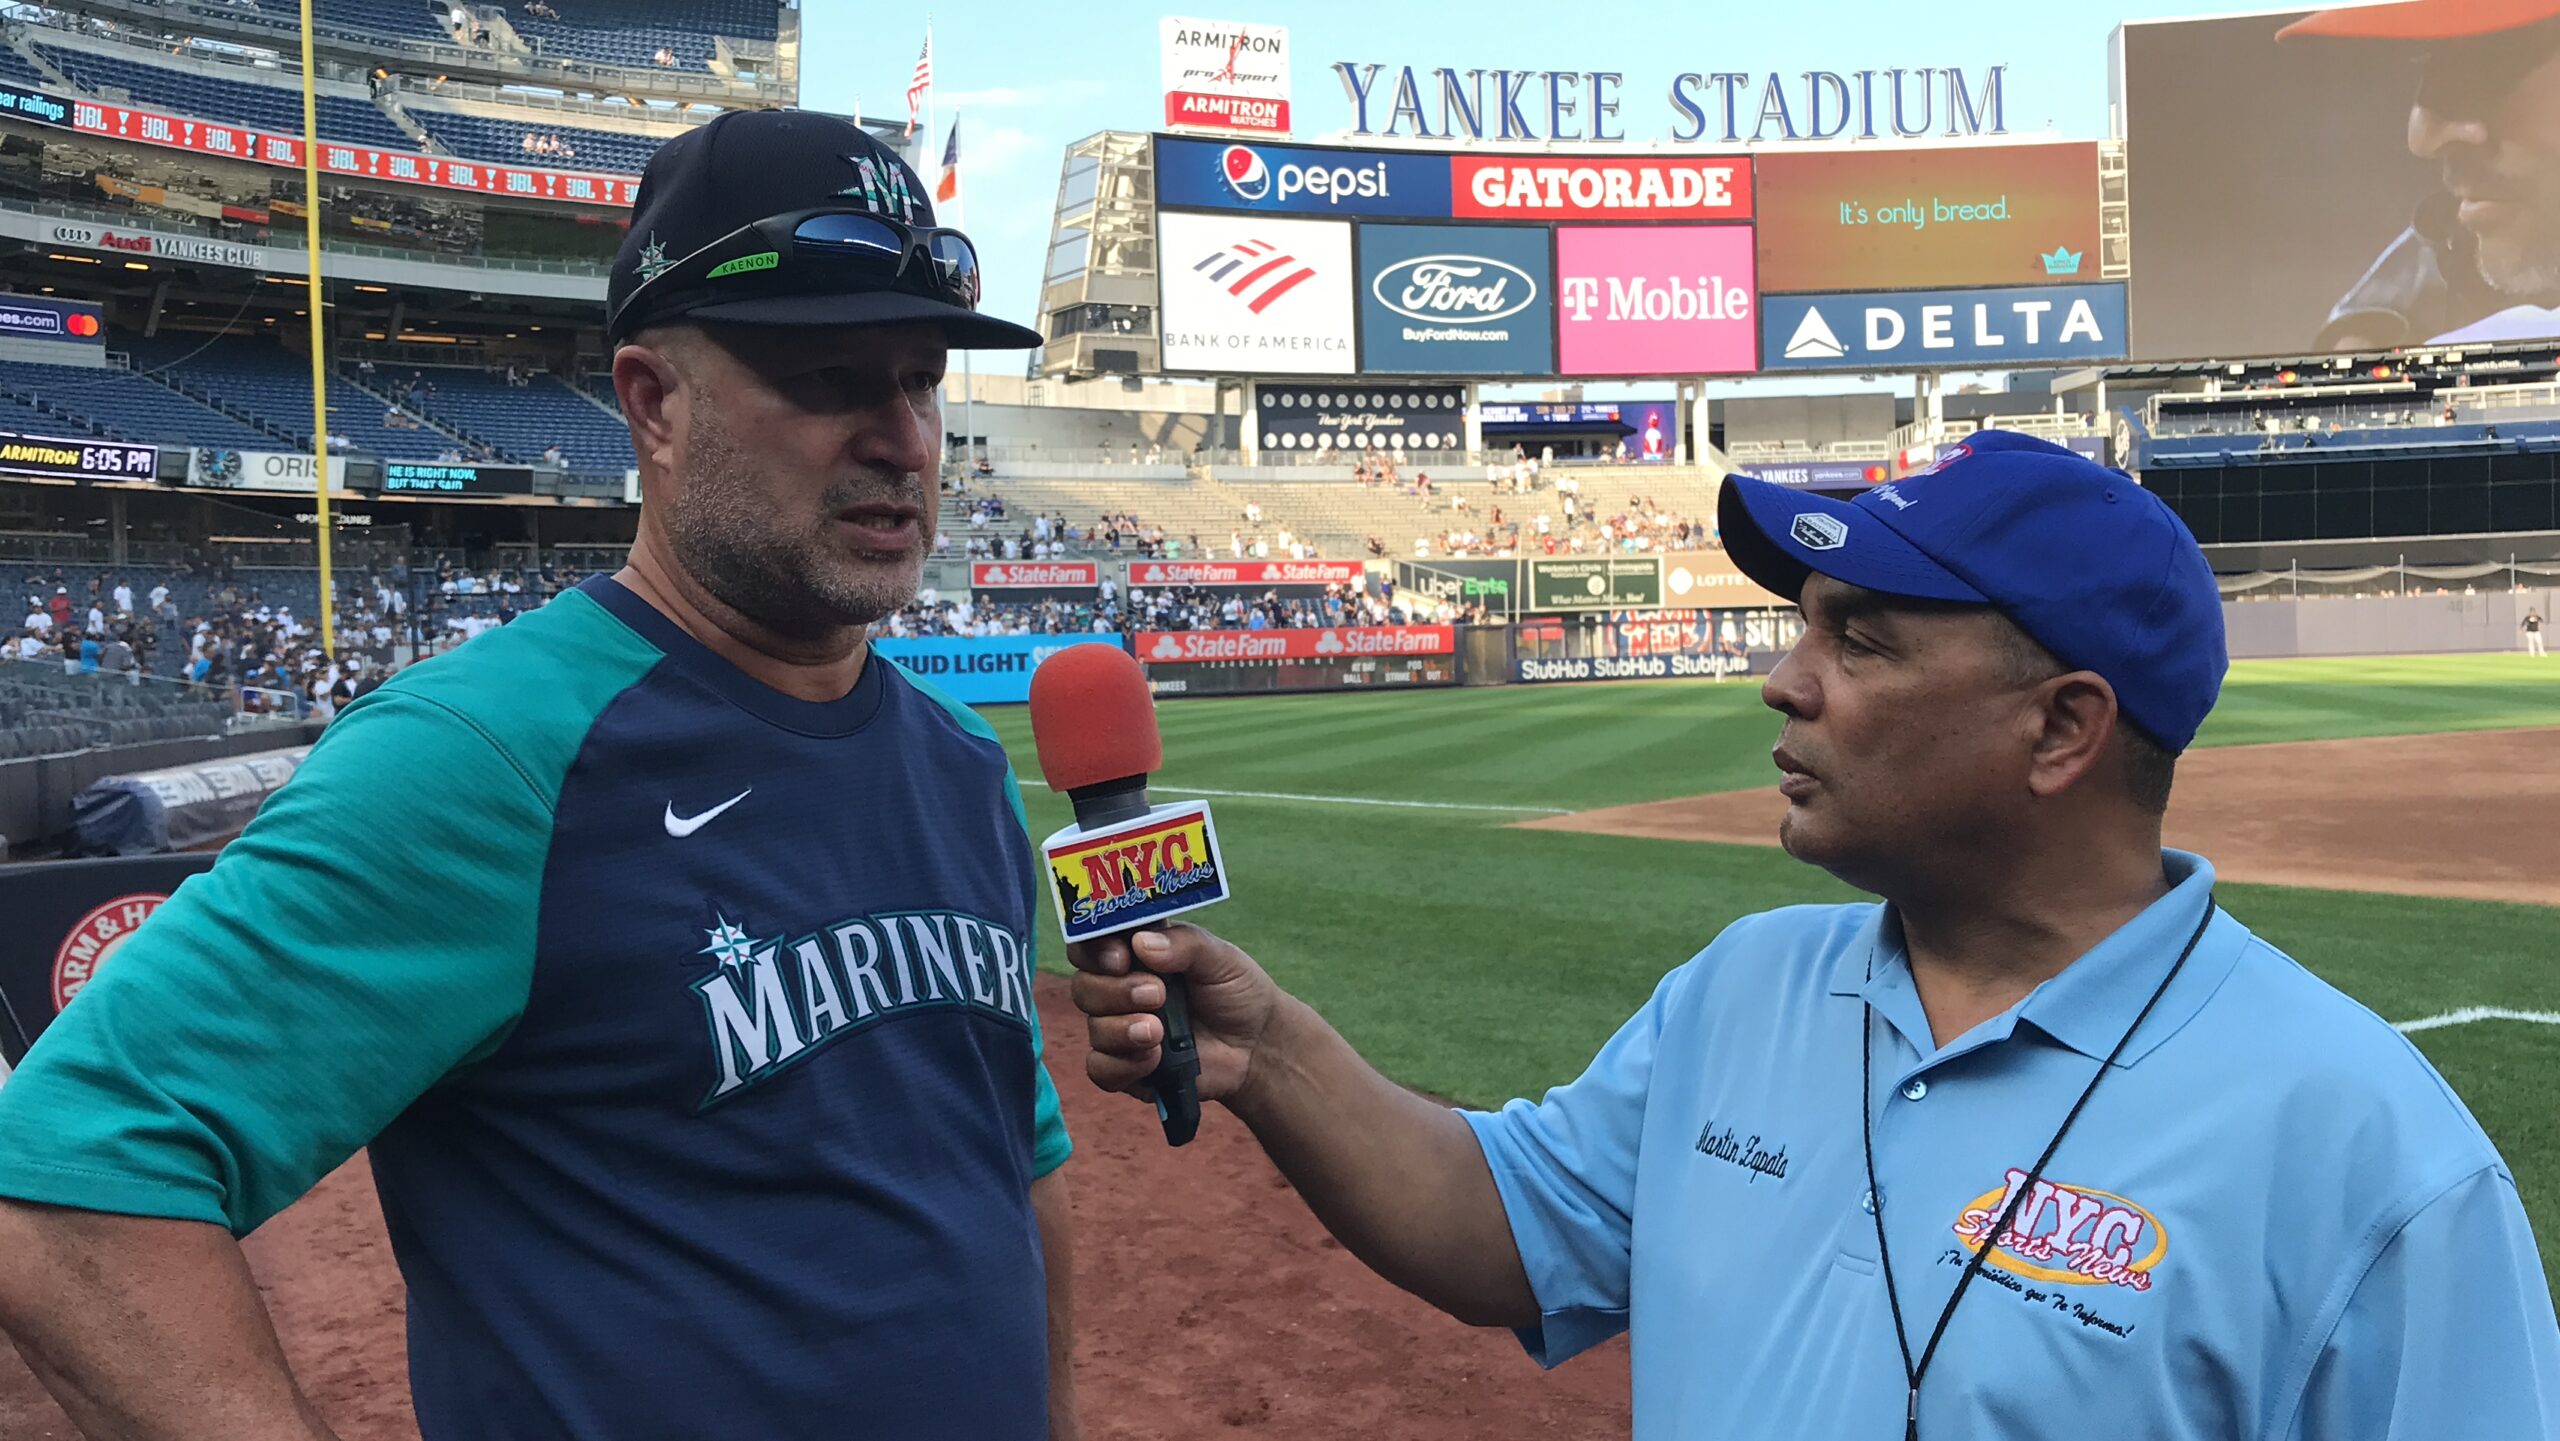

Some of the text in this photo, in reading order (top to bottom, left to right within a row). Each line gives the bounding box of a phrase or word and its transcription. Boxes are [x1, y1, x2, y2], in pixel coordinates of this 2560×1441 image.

[1175, 29, 1281, 54] ARMITRON
[19, 94, 64, 121] railings
[1182, 96, 1279, 118] ARMITRON
[1331, 61, 2009, 143] YANKEE STADIUM
[1229, 115, 1277, 128] WATCHES
[1278, 161, 1388, 204] pepsi
[1471, 167, 1732, 208] GATORADE
[1839, 194, 2012, 230] It's only bread.
[100, 231, 262, 266] Audi YANKEES CLUB
[722, 254, 776, 274] KAENON
[1402, 263, 1508, 312] Ford
[1605, 276, 1748, 321] Mobile
[0, 311, 55, 329] es.com
[1865, 299, 2103, 351] DELTA
[1166, 333, 1347, 351] BANK OF AMERICA
[1402, 327, 1509, 342] BuyFordNow.com
[1316, 413, 1405, 431] New York Yankees
[1, 443, 151, 473] ARMITRON 6:05 PM
[388, 477, 409, 489] BUT
[410, 478, 436, 489] THAT
[389, 465, 477, 482] HE IS RIGHT NOW,
[1419, 575, 1509, 597] Uber Eats
[1696, 574, 1744, 587] LOTTE
[954, 652, 1029, 674] LIGHT
[1521, 659, 1590, 681] StubHub
[1594, 657, 1666, 679] StubHub
[1081, 831, 1194, 901] NYC
[1072, 862, 1214, 926] Sports News
[63, 915, 121, 998] ARM &
[690, 908, 1032, 1110] MARINER
[1695, 1120, 1789, 1184] Martin Zapata
[1990, 1168, 2144, 1267] NYC
[1952, 1208, 2152, 1291] Sports News
[2024, 1288, 2047, 1302] que
[2051, 1293, 2068, 1312] Te
